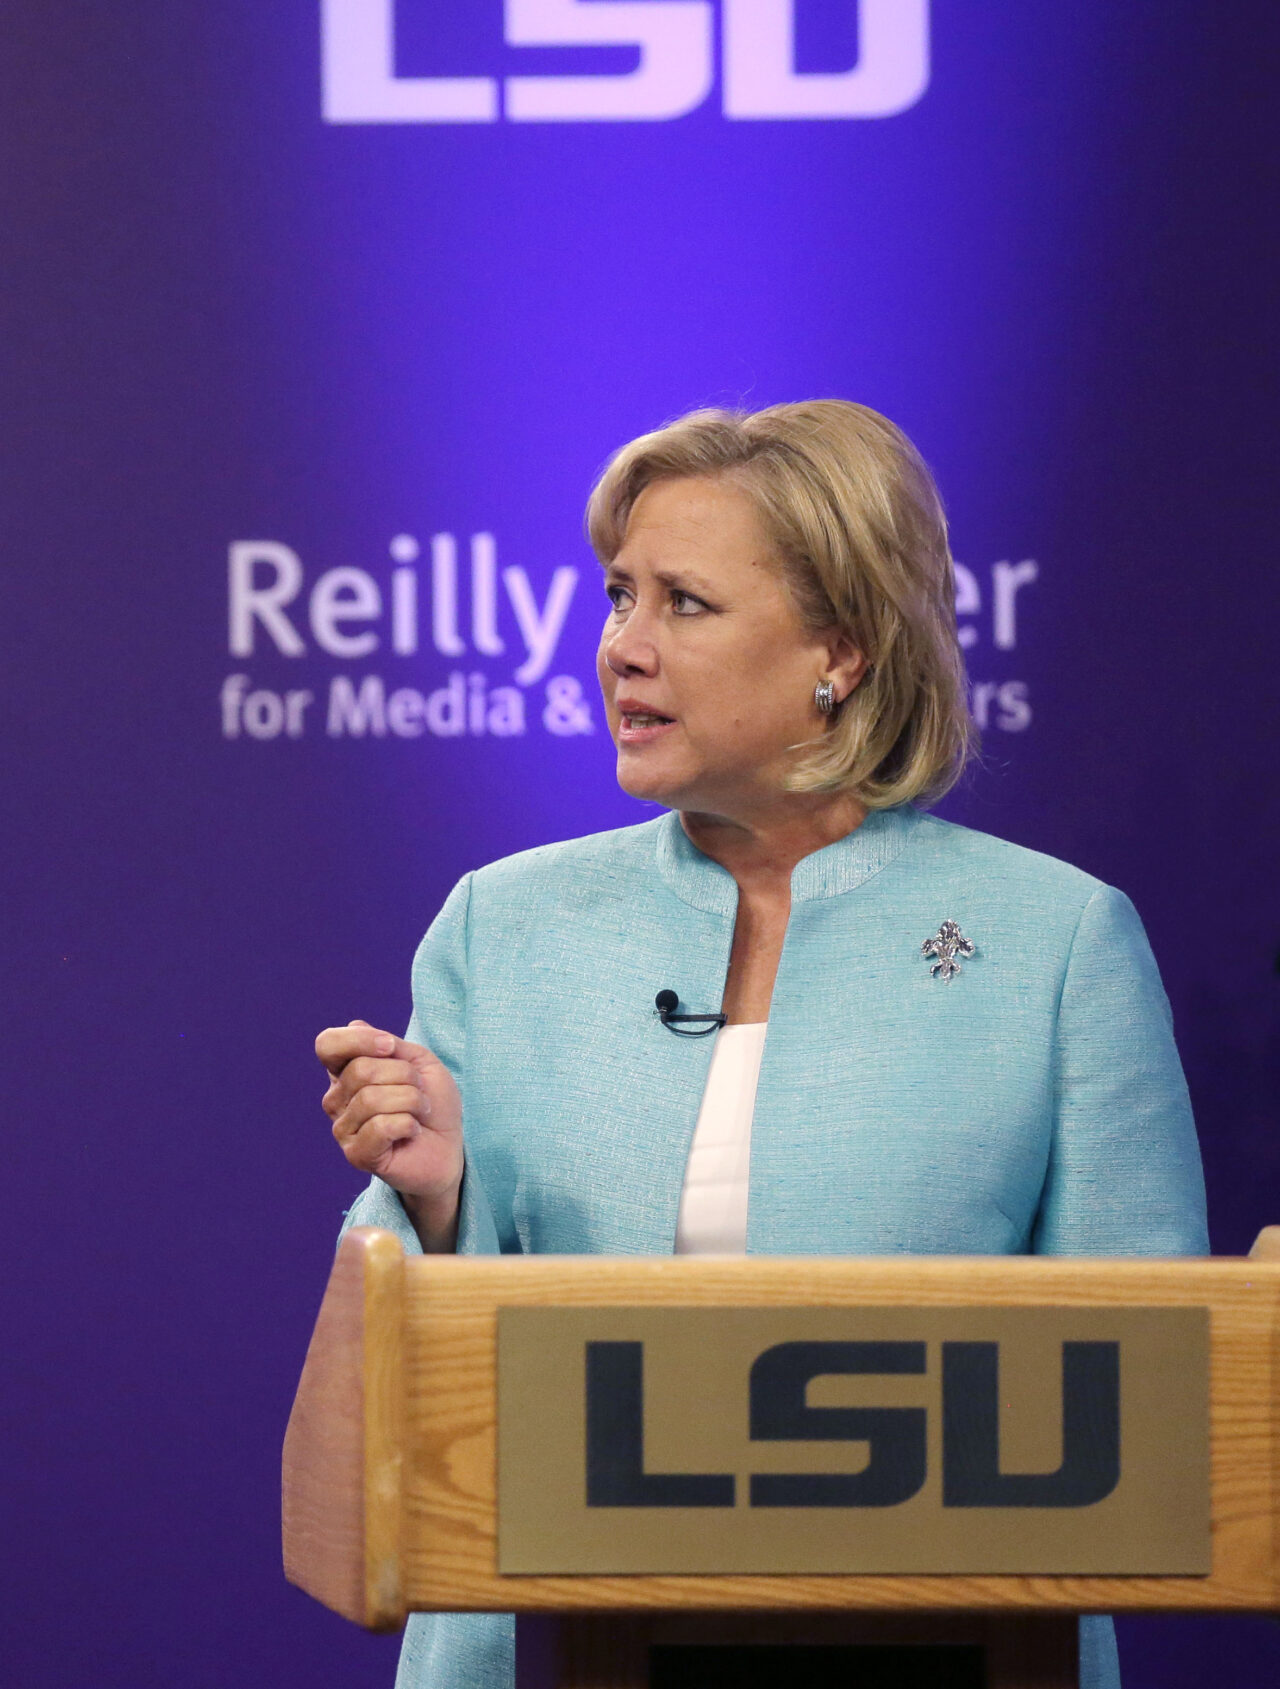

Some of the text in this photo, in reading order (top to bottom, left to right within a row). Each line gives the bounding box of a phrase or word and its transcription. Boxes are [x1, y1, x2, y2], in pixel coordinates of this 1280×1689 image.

[227, 531, 580, 687] Reilly
[221, 670, 596, 740] for Media &
[585, 1340, 1121, 1508] LSU
